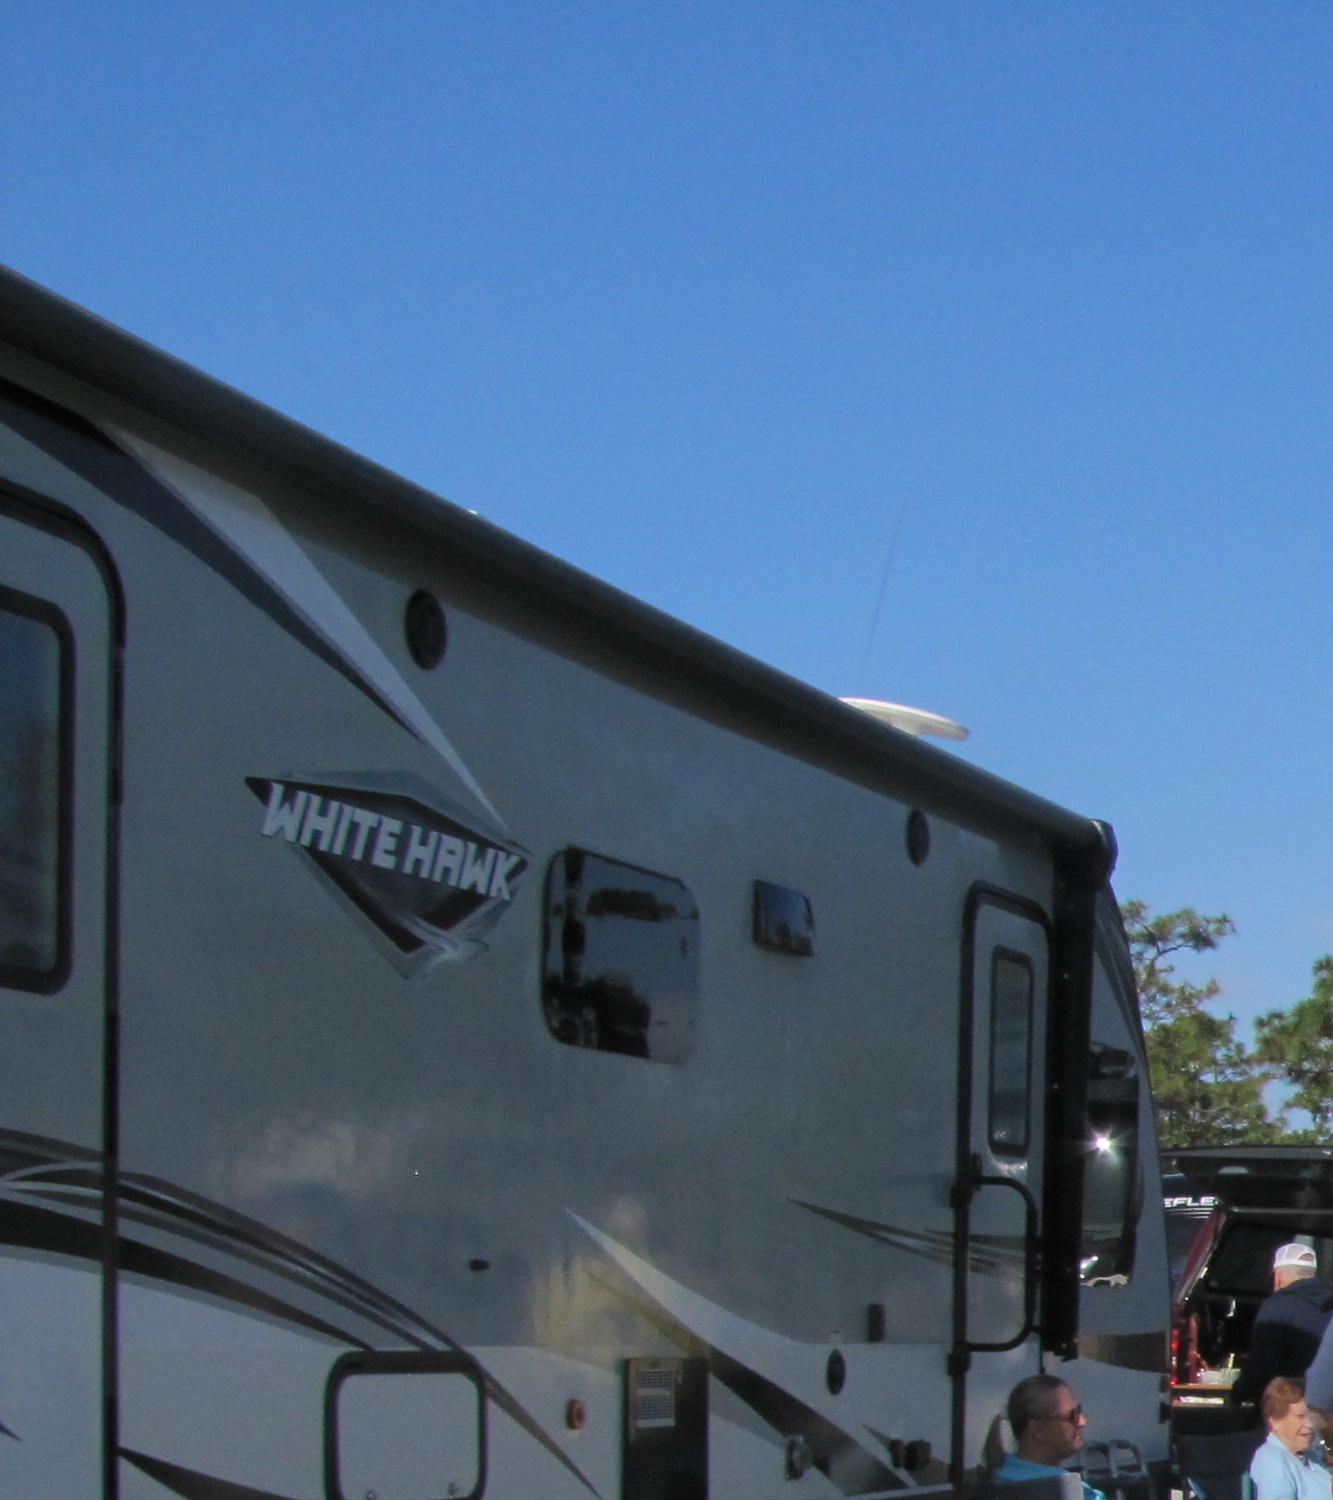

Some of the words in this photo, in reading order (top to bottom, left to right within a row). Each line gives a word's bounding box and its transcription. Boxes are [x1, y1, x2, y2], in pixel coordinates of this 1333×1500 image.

[262, 781, 403, 869] WHITE
[403, 824, 523, 900] HAWK
[1163, 1196, 1218, 1208] EFLE
